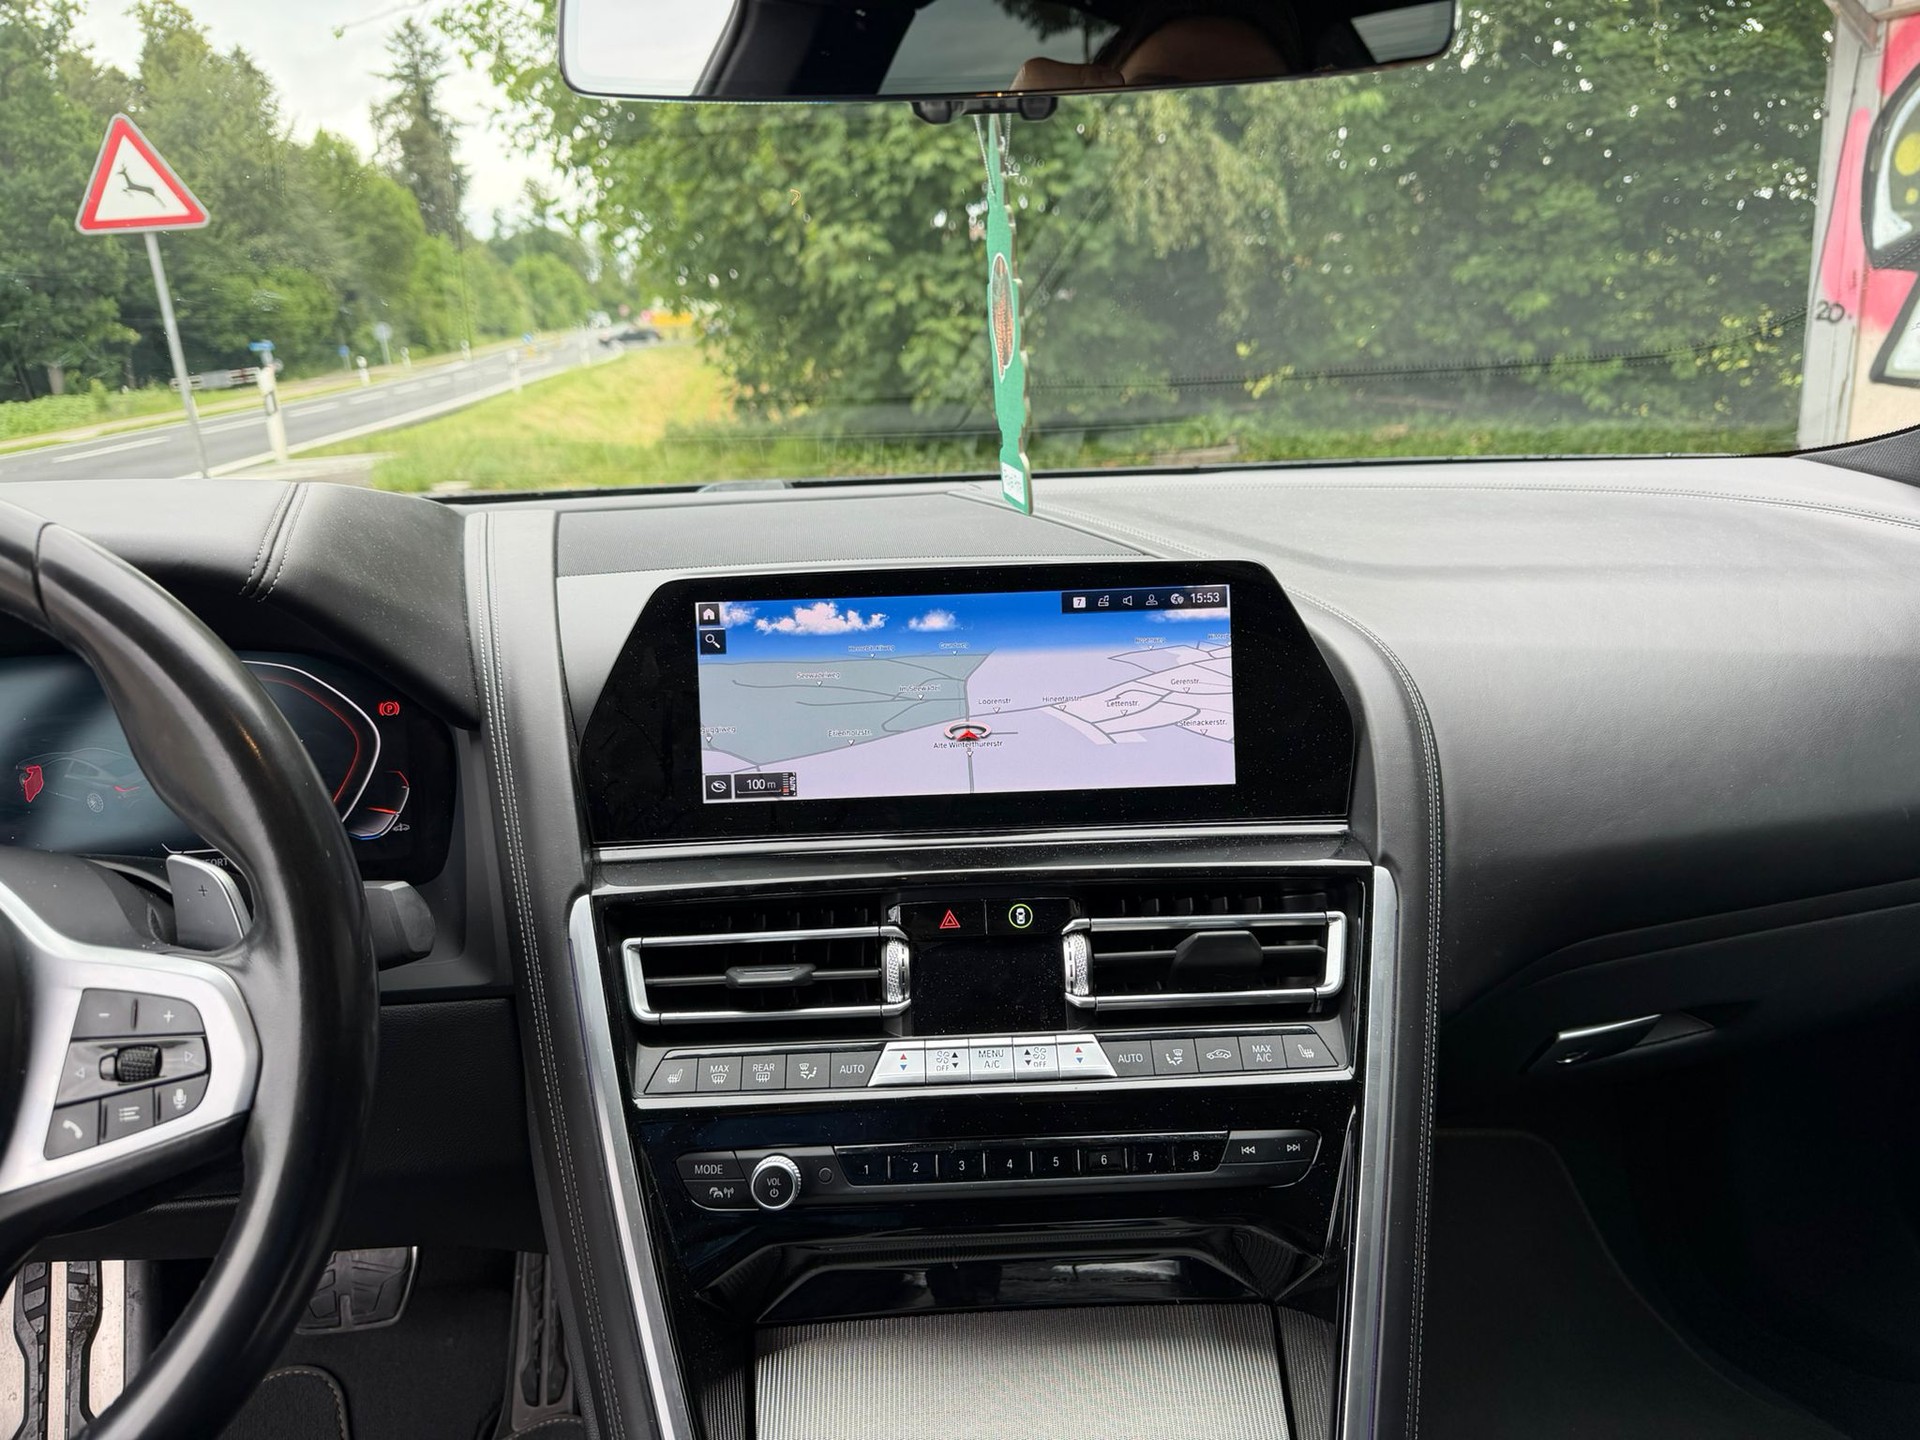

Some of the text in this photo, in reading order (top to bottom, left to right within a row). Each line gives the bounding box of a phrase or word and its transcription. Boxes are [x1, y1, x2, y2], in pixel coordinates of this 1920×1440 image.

[1190, 593, 1220, 603] 15:53
[1179, 719, 1228, 727] Steinackerstr.
[746, 779, 765, 789] 100
[1252, 1044, 1272, 1053] MAX
[978, 1049, 1004, 1059] MENU
[1117, 1053, 1144, 1063] AUTO
[1255, 1053, 1273, 1063] A/C
[709, 1065, 730, 1073] MAX
[752, 1063, 775, 1072] REAR
[839, 1064, 865, 1074] AUTO
[984, 1059, 1000, 1069] A/C
[1033, 1060, 1047, 1068] OFF
[912, 1162, 919, 1173] 2
[958, 1160, 966, 1171] 3
[1006, 1159, 1013, 1169] 4
[1053, 1156, 1060, 1167] 5
[1100, 1154, 1108, 1165] 6
[1147, 1153, 1154, 1163] 7
[1193, 1150, 1200, 1161] 8
[694, 1164, 723, 1175] MODE
[766, 1178, 782, 1186] VOL
